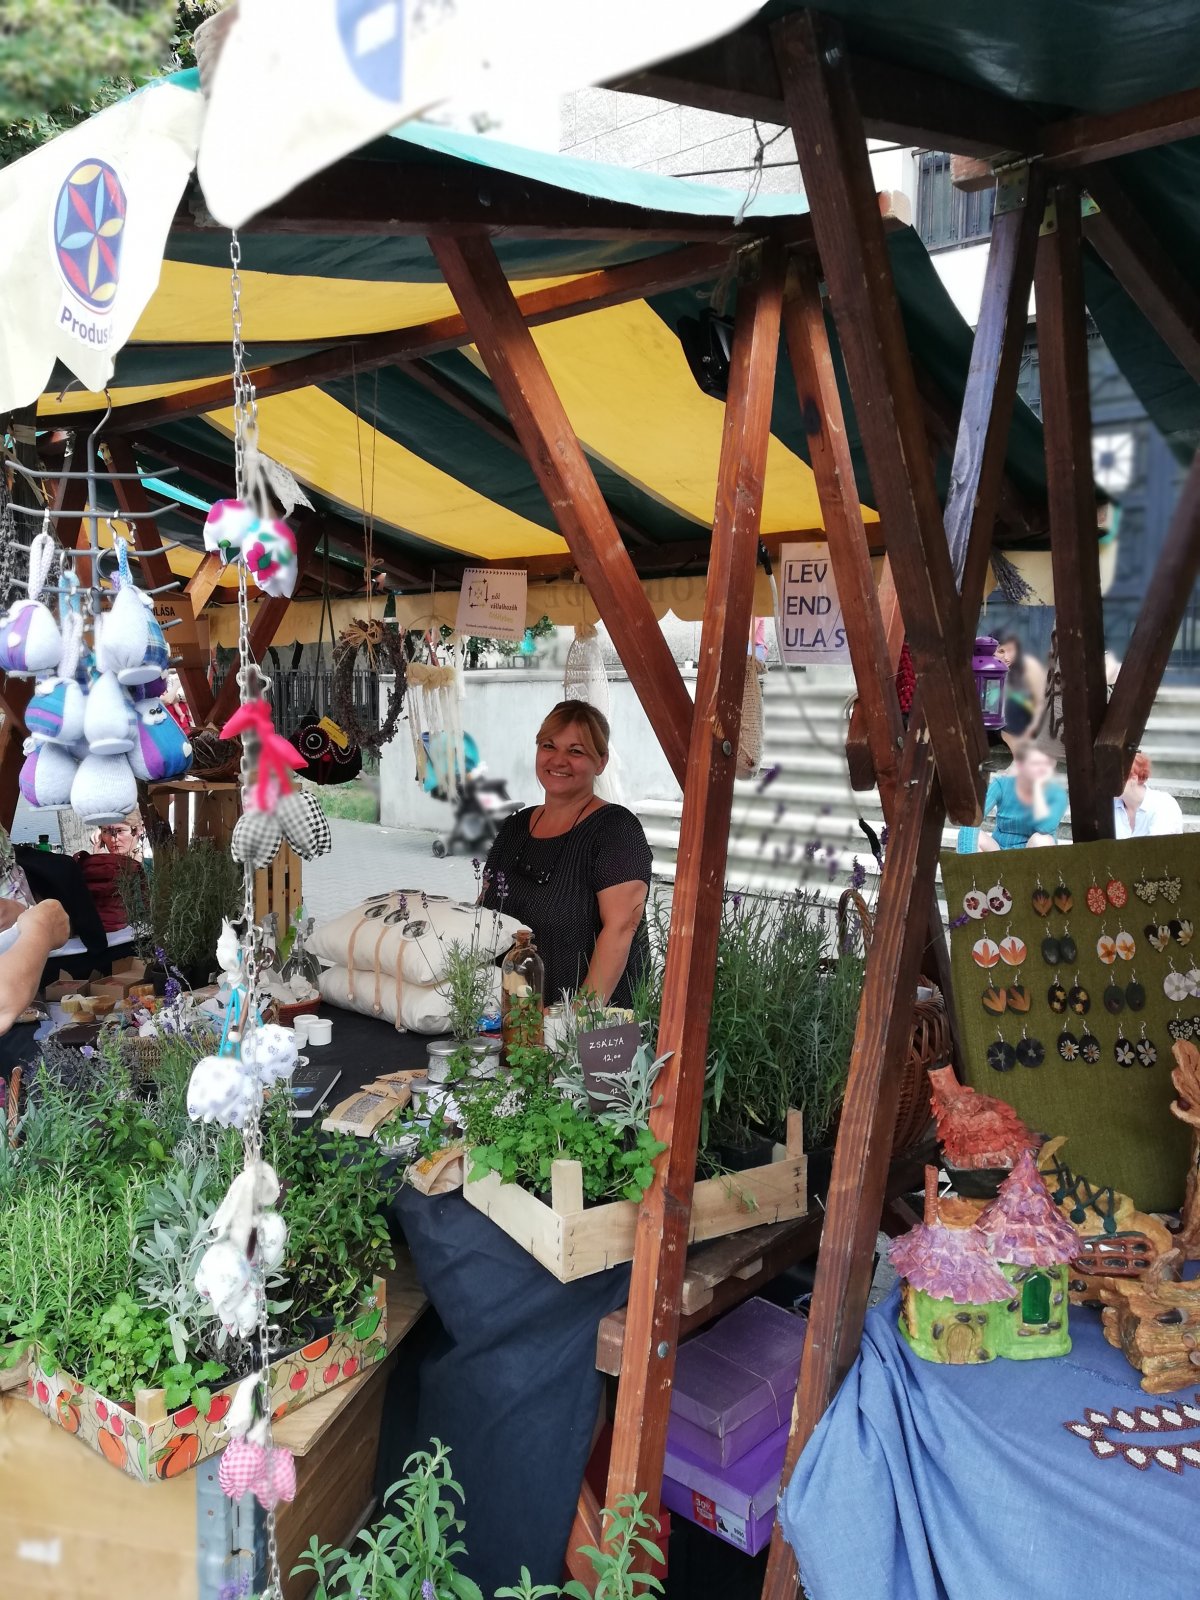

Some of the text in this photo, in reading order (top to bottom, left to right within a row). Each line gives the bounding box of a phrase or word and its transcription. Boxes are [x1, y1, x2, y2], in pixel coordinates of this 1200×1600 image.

[787, 563, 828, 583] LEV
[786, 596, 832, 616] END
[785, 628, 827, 648] ULA
[589, 1037, 625, 1050] ZSÁLYA
